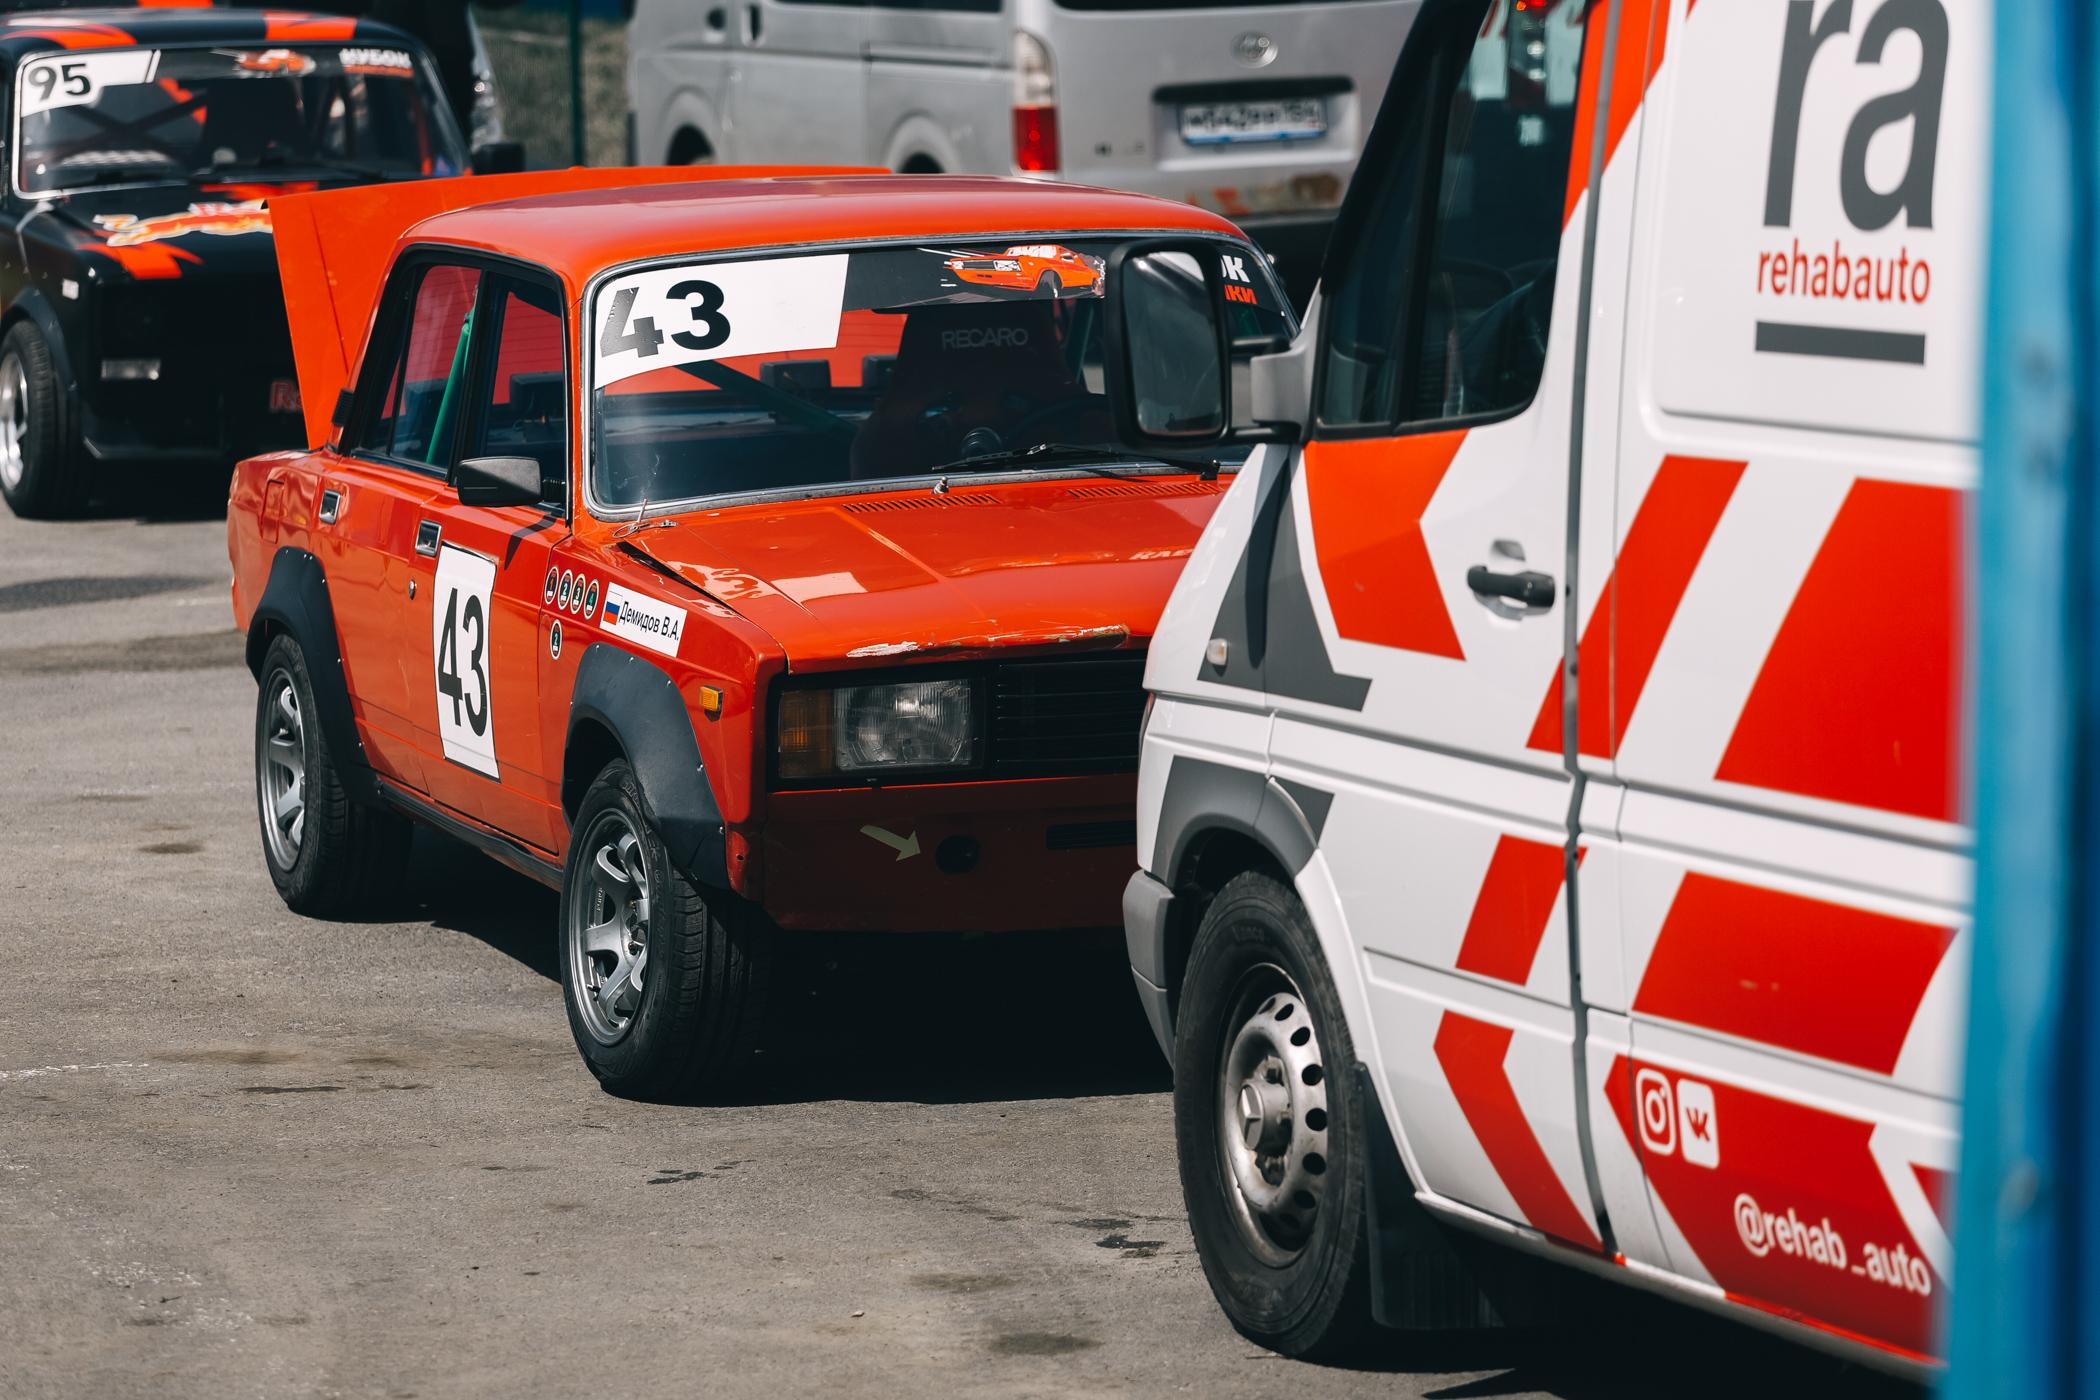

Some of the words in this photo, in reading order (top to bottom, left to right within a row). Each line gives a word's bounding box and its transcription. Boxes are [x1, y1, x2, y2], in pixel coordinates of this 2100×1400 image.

[28, 63, 91, 101] 95
[1763, 0, 1950, 232] ra
[1757, 238, 1931, 304] rehabauto
[600, 279, 731, 358] 43
[941, 327, 1028, 350] RECARO
[619, 600, 661, 633] Демидов
[438, 587, 488, 737] 43
